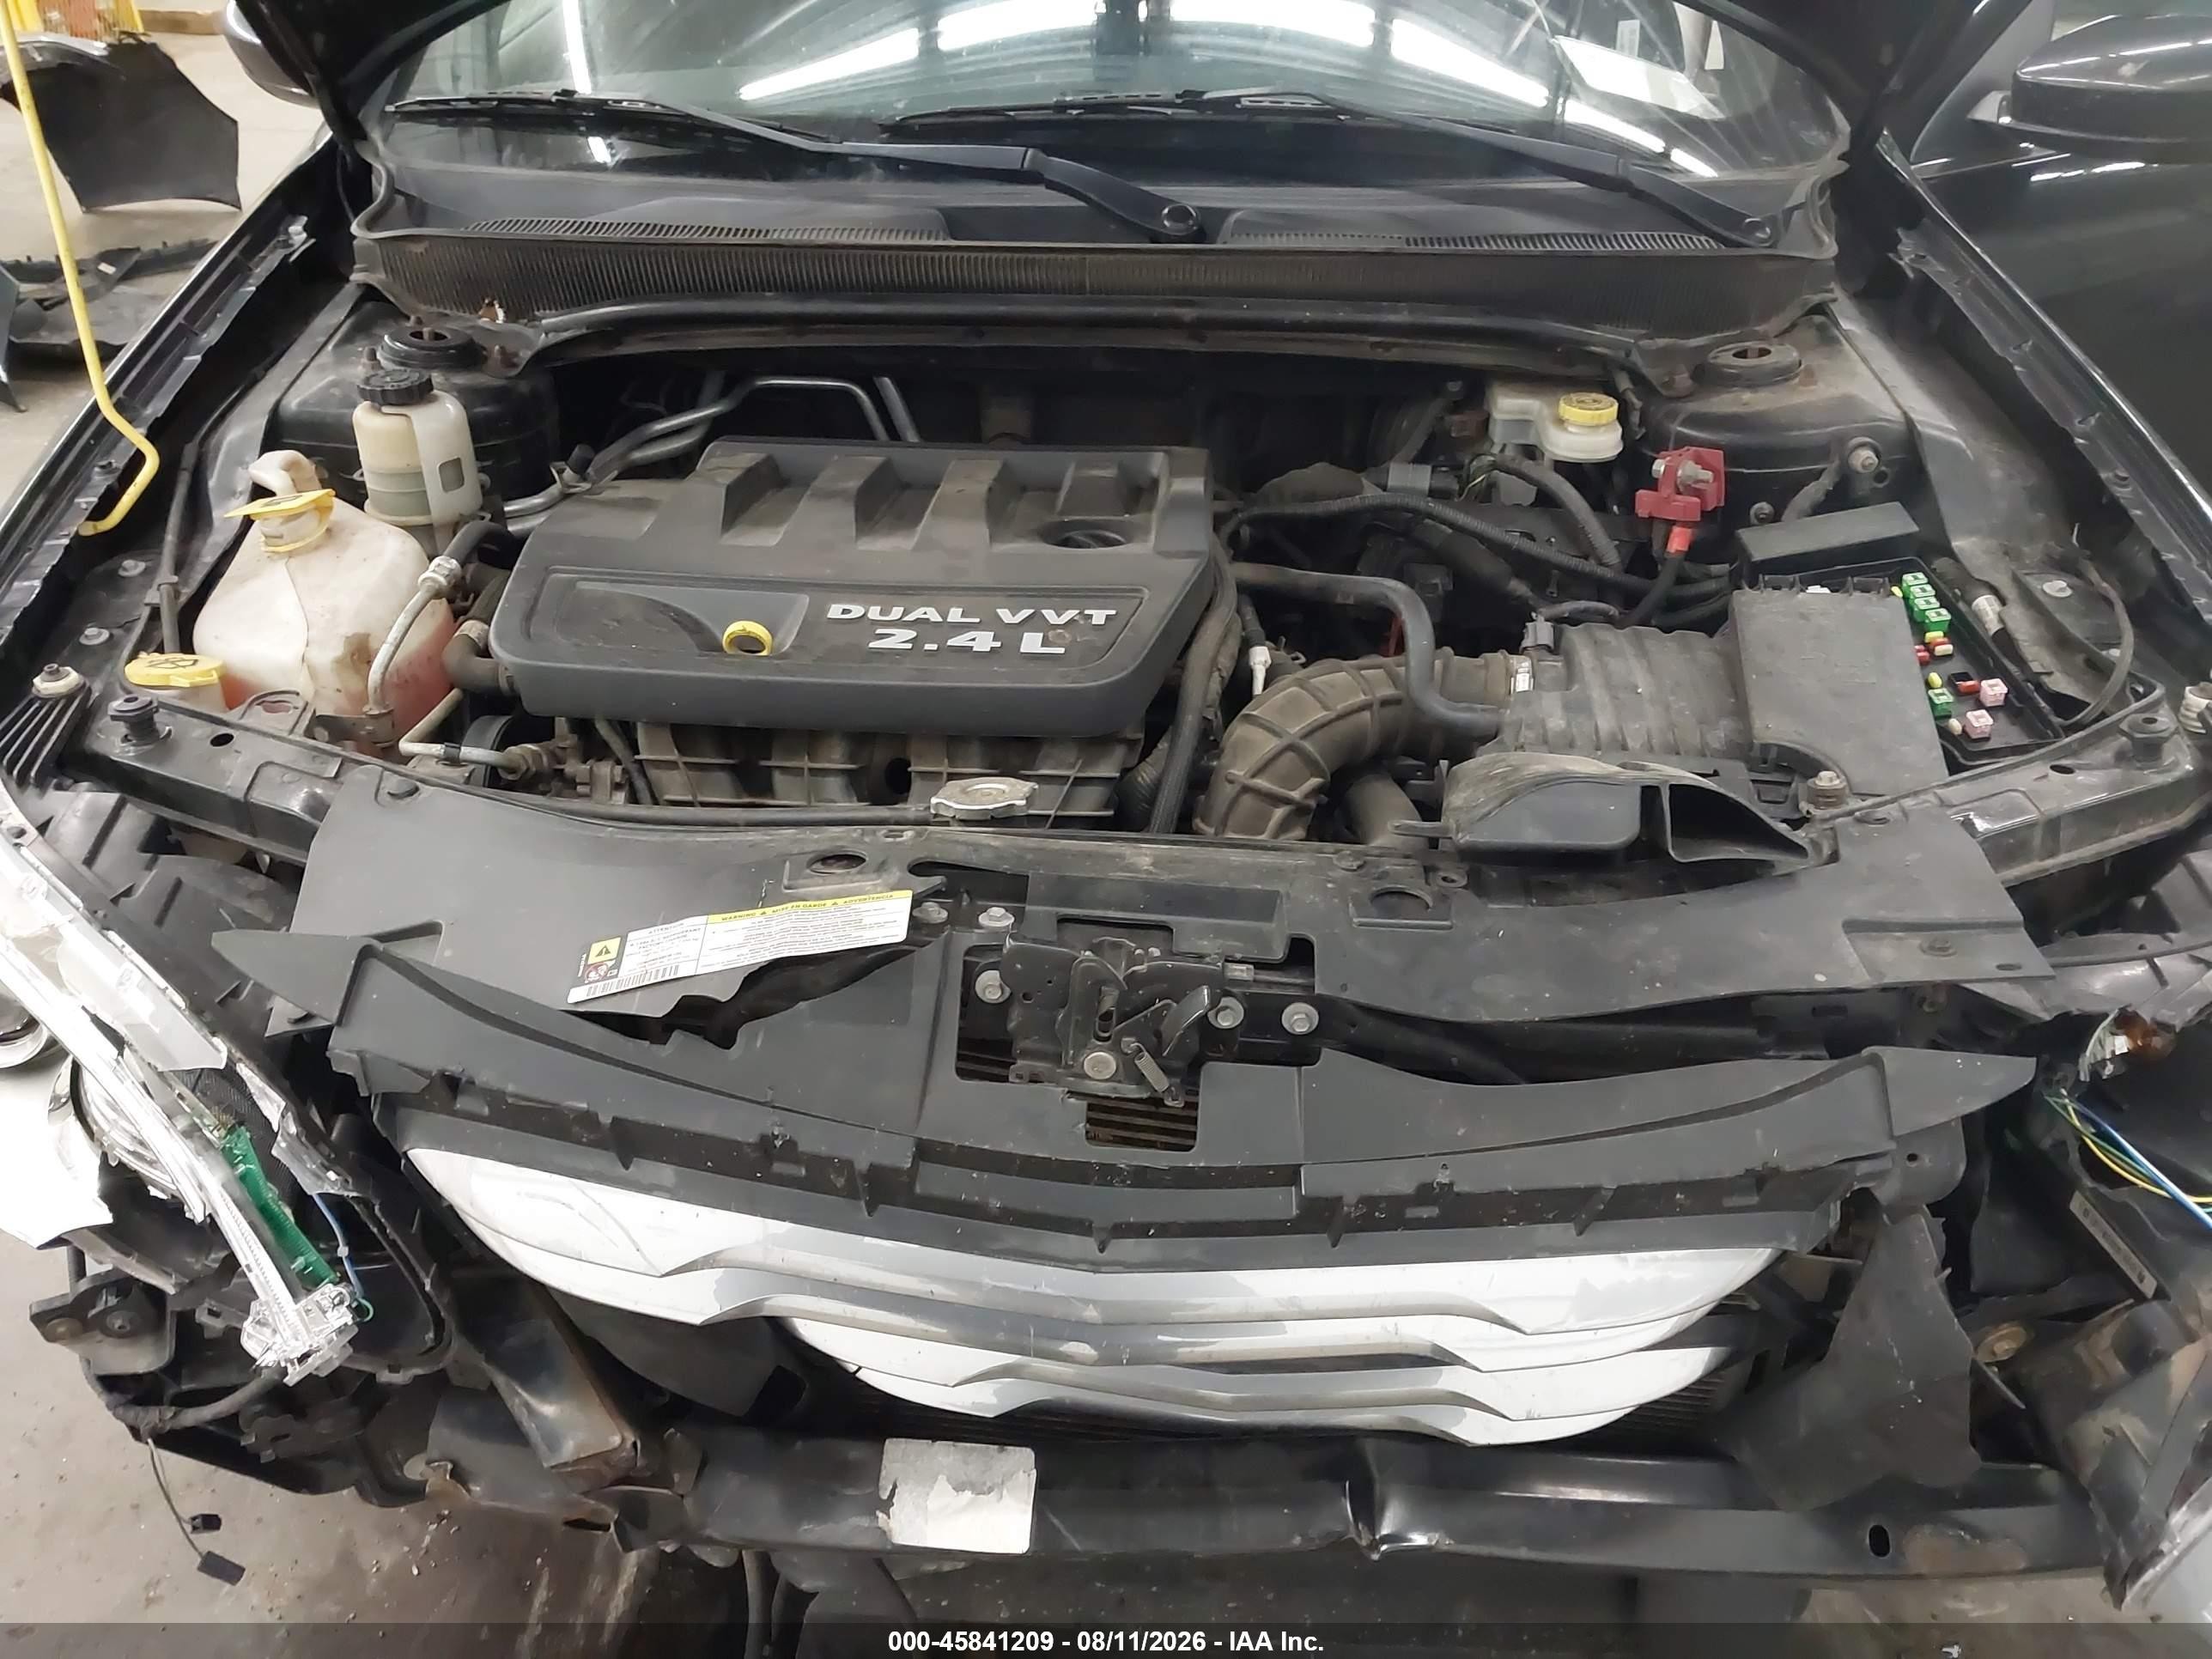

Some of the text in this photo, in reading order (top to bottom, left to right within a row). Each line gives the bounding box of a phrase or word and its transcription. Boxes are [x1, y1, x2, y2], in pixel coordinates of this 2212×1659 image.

[826, 604, 1118, 626] DUAL VVT
[867, 629, 1066, 654] 2.4 L
